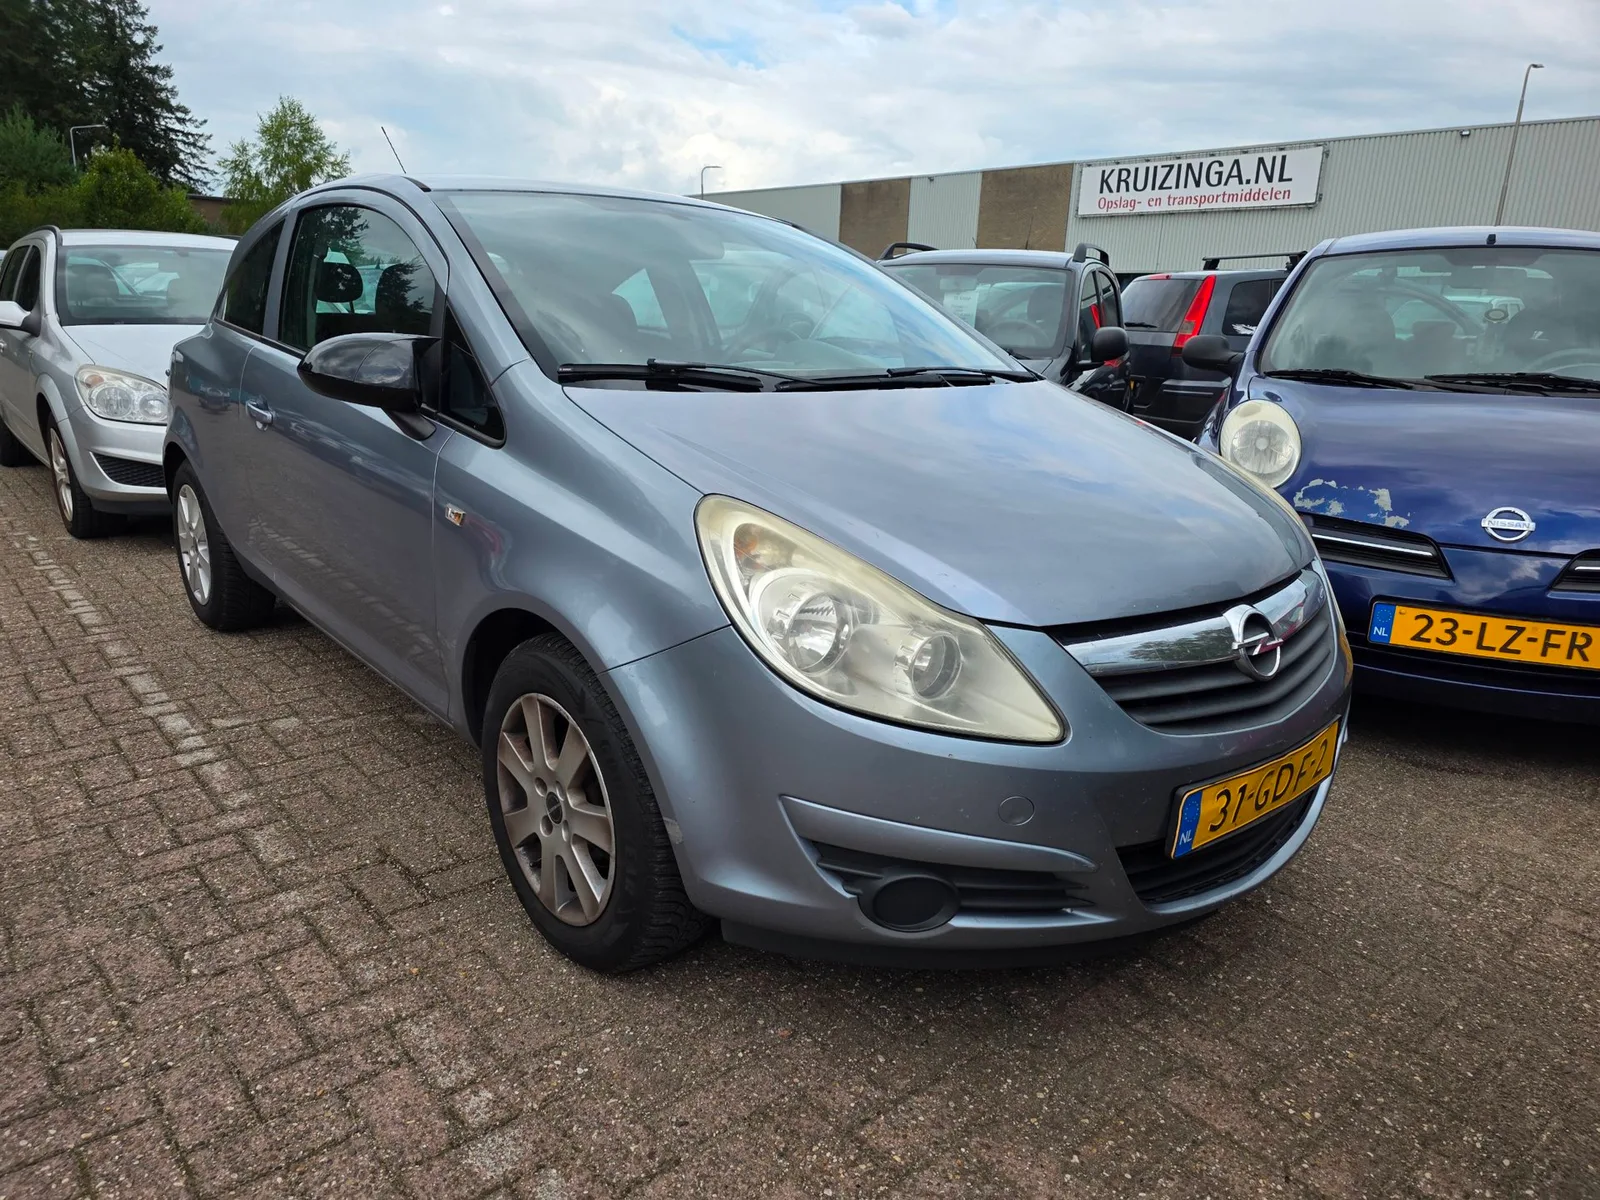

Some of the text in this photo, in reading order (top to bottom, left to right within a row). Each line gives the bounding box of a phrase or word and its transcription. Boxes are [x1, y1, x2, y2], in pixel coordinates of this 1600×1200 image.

[1099, 154, 1293, 194] KRUIZINGA.NL
[1097, 187, 1292, 212] Opslag- en transportmiddelen
[1487, 519, 1531, 529] NISSAN
[1373, 626, 1389, 638] NL
[1410, 614, 1593, 662] 23-LZ-FR
[1208, 738, 1328, 832] 31-GDF-2
[1178, 830, 1193, 845] NL
